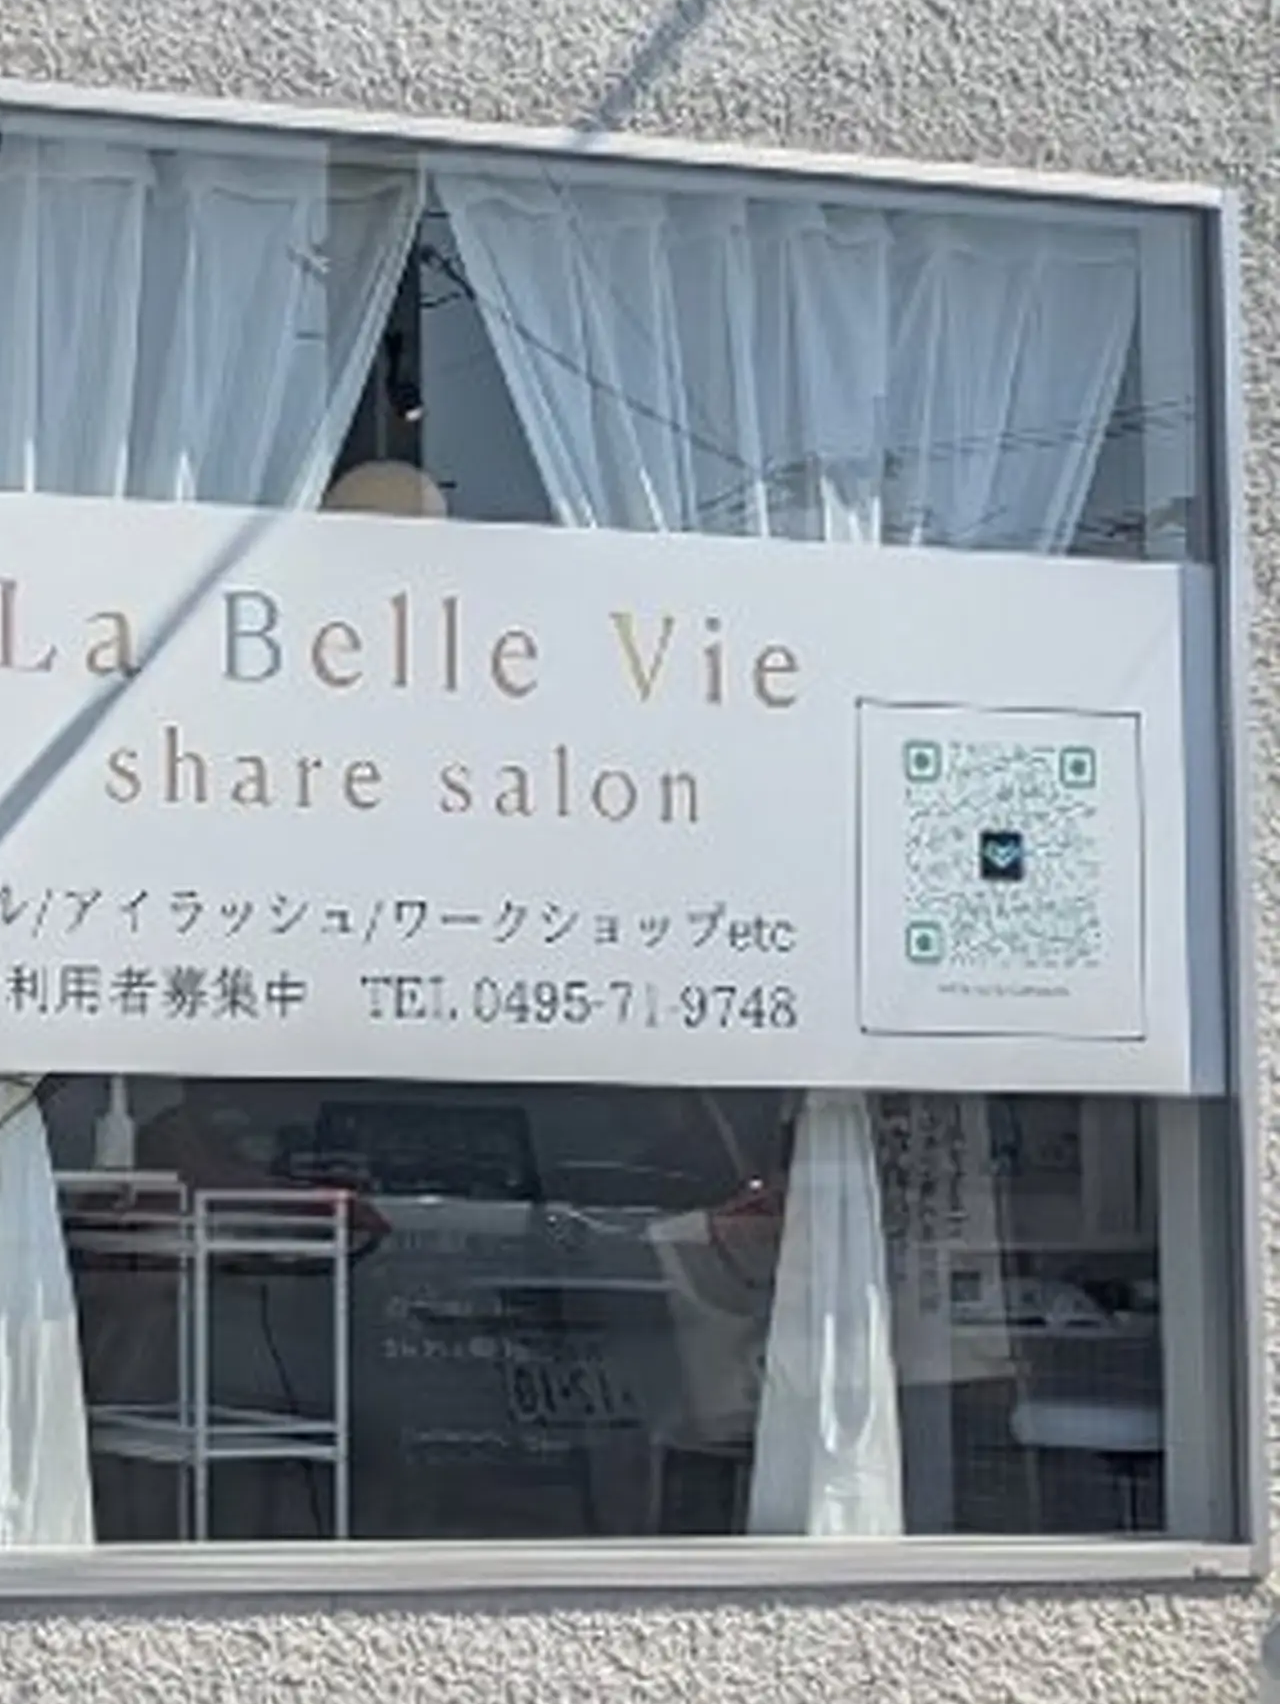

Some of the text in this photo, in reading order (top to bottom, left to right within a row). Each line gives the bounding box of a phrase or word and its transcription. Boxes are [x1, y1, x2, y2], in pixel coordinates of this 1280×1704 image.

[220, 588, 540, 697] Belle
[608, 611, 801, 709] Vie
[104, 725, 701, 825] share salon
